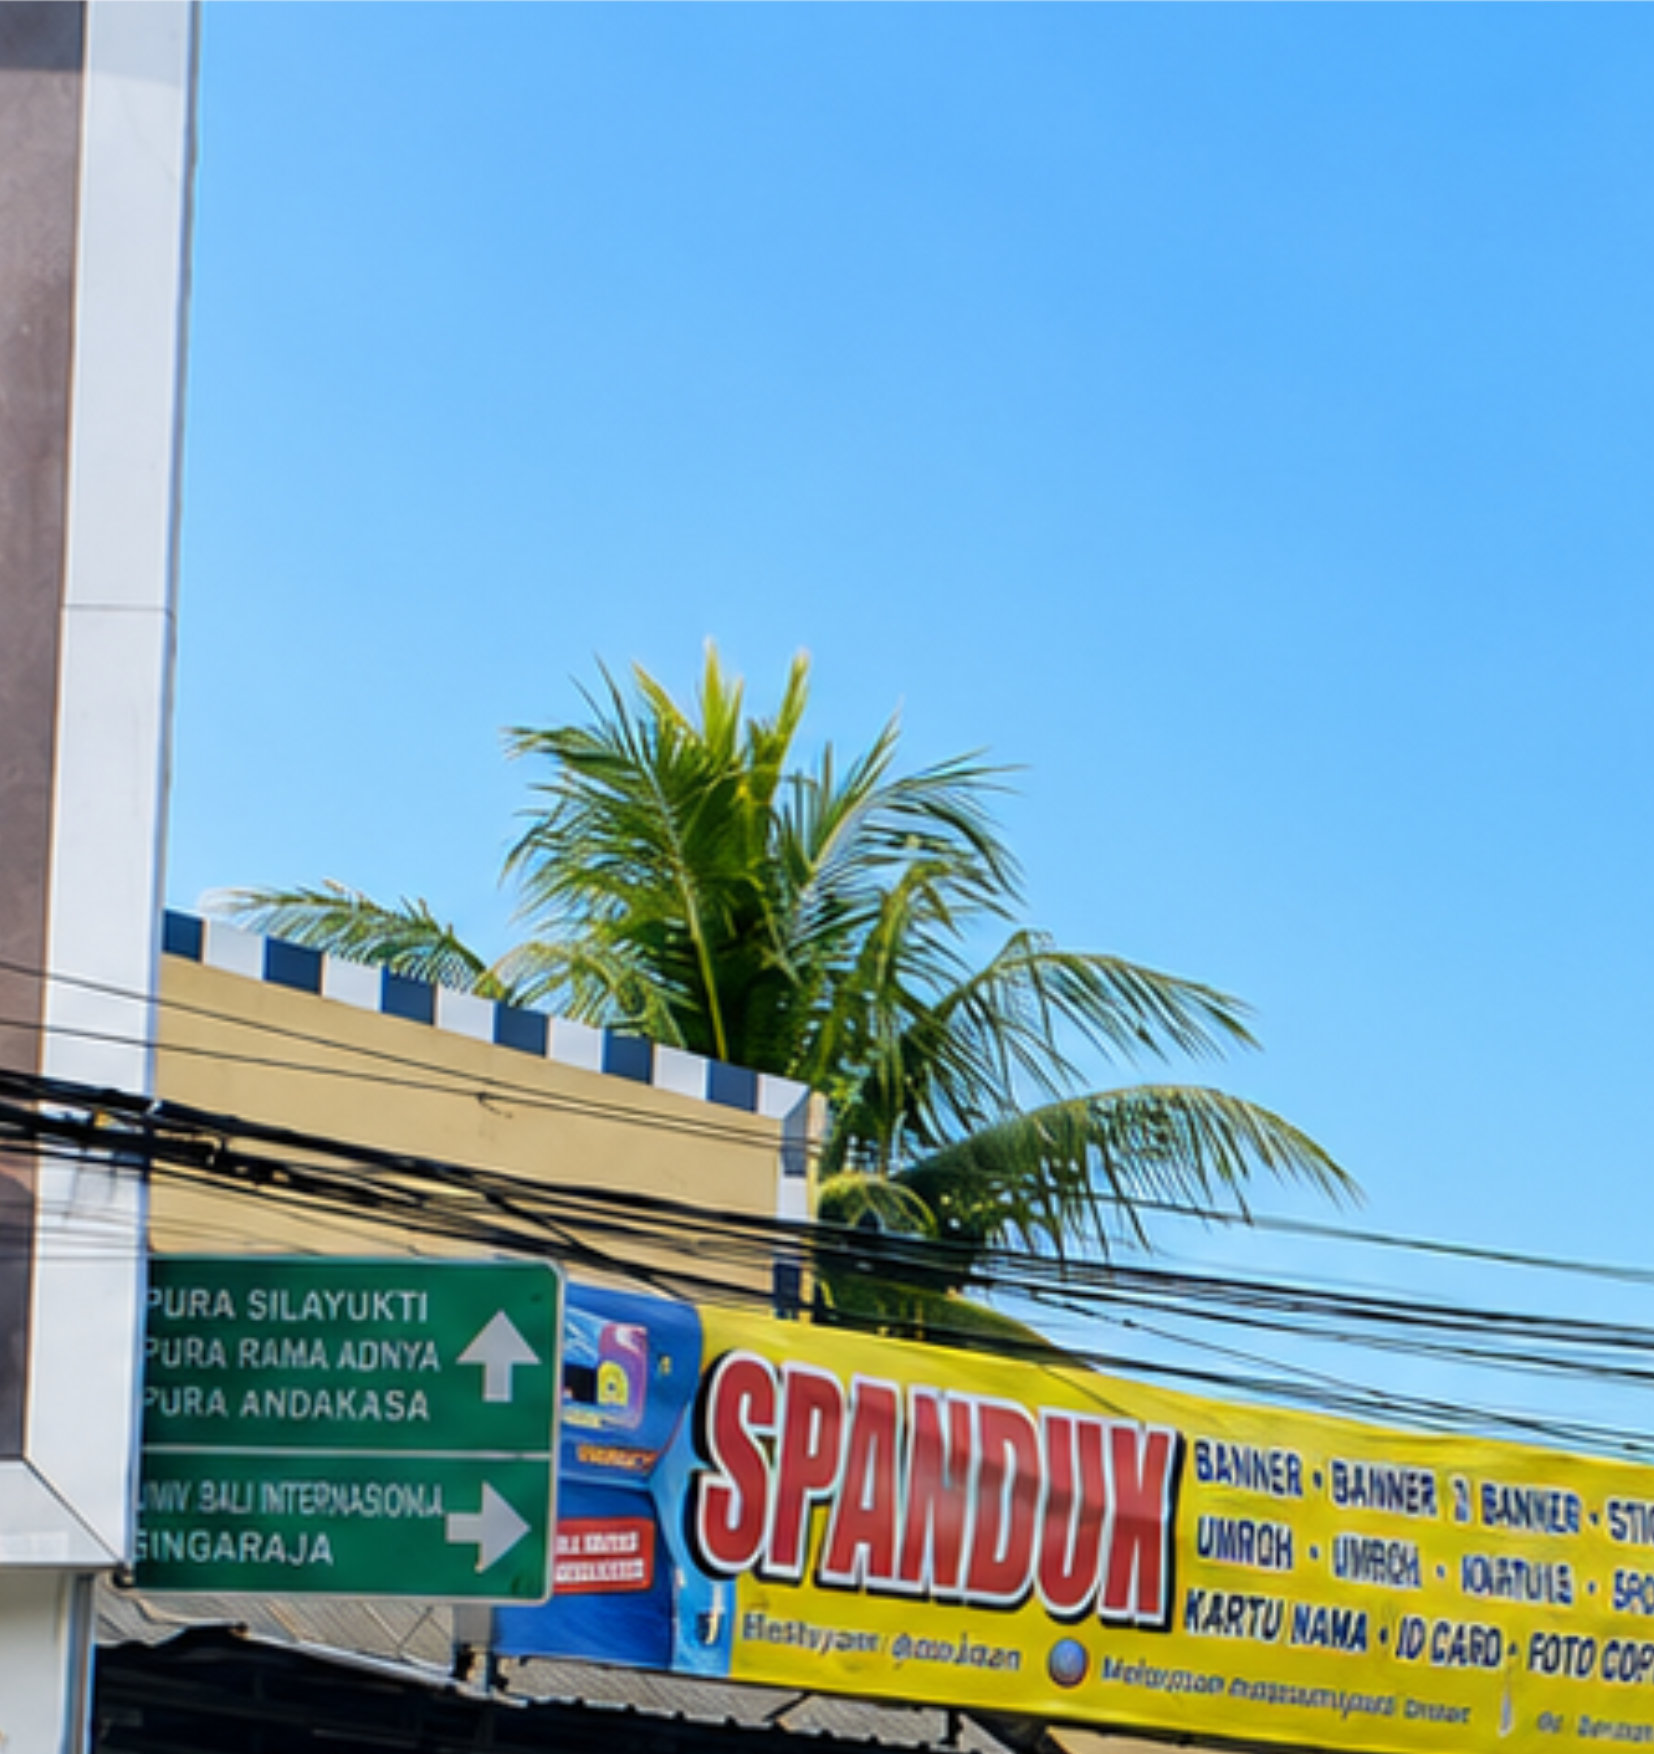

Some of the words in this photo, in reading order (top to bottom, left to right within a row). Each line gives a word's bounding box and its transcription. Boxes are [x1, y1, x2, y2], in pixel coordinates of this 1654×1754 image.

[247, 1290, 428, 1322] SILAYUKTI
[238, 1339, 328, 1371] RAMA
[336, 1341, 440, 1372] ADNYA
[239, 1390, 430, 1421] ANDAKASA
[695, 1350, 1181, 1628] SPANDUK
[1194, 1440, 1304, 1497] BANNER
[1331, 1460, 1438, 1516] BANNER
[1197, 1517, 1293, 1569] UMROH
[1184, 1589, 1284, 1641] KARTU
[1290, 1603, 1367, 1651] NAMA
[1529, 1632, 1596, 1677] FOTO
